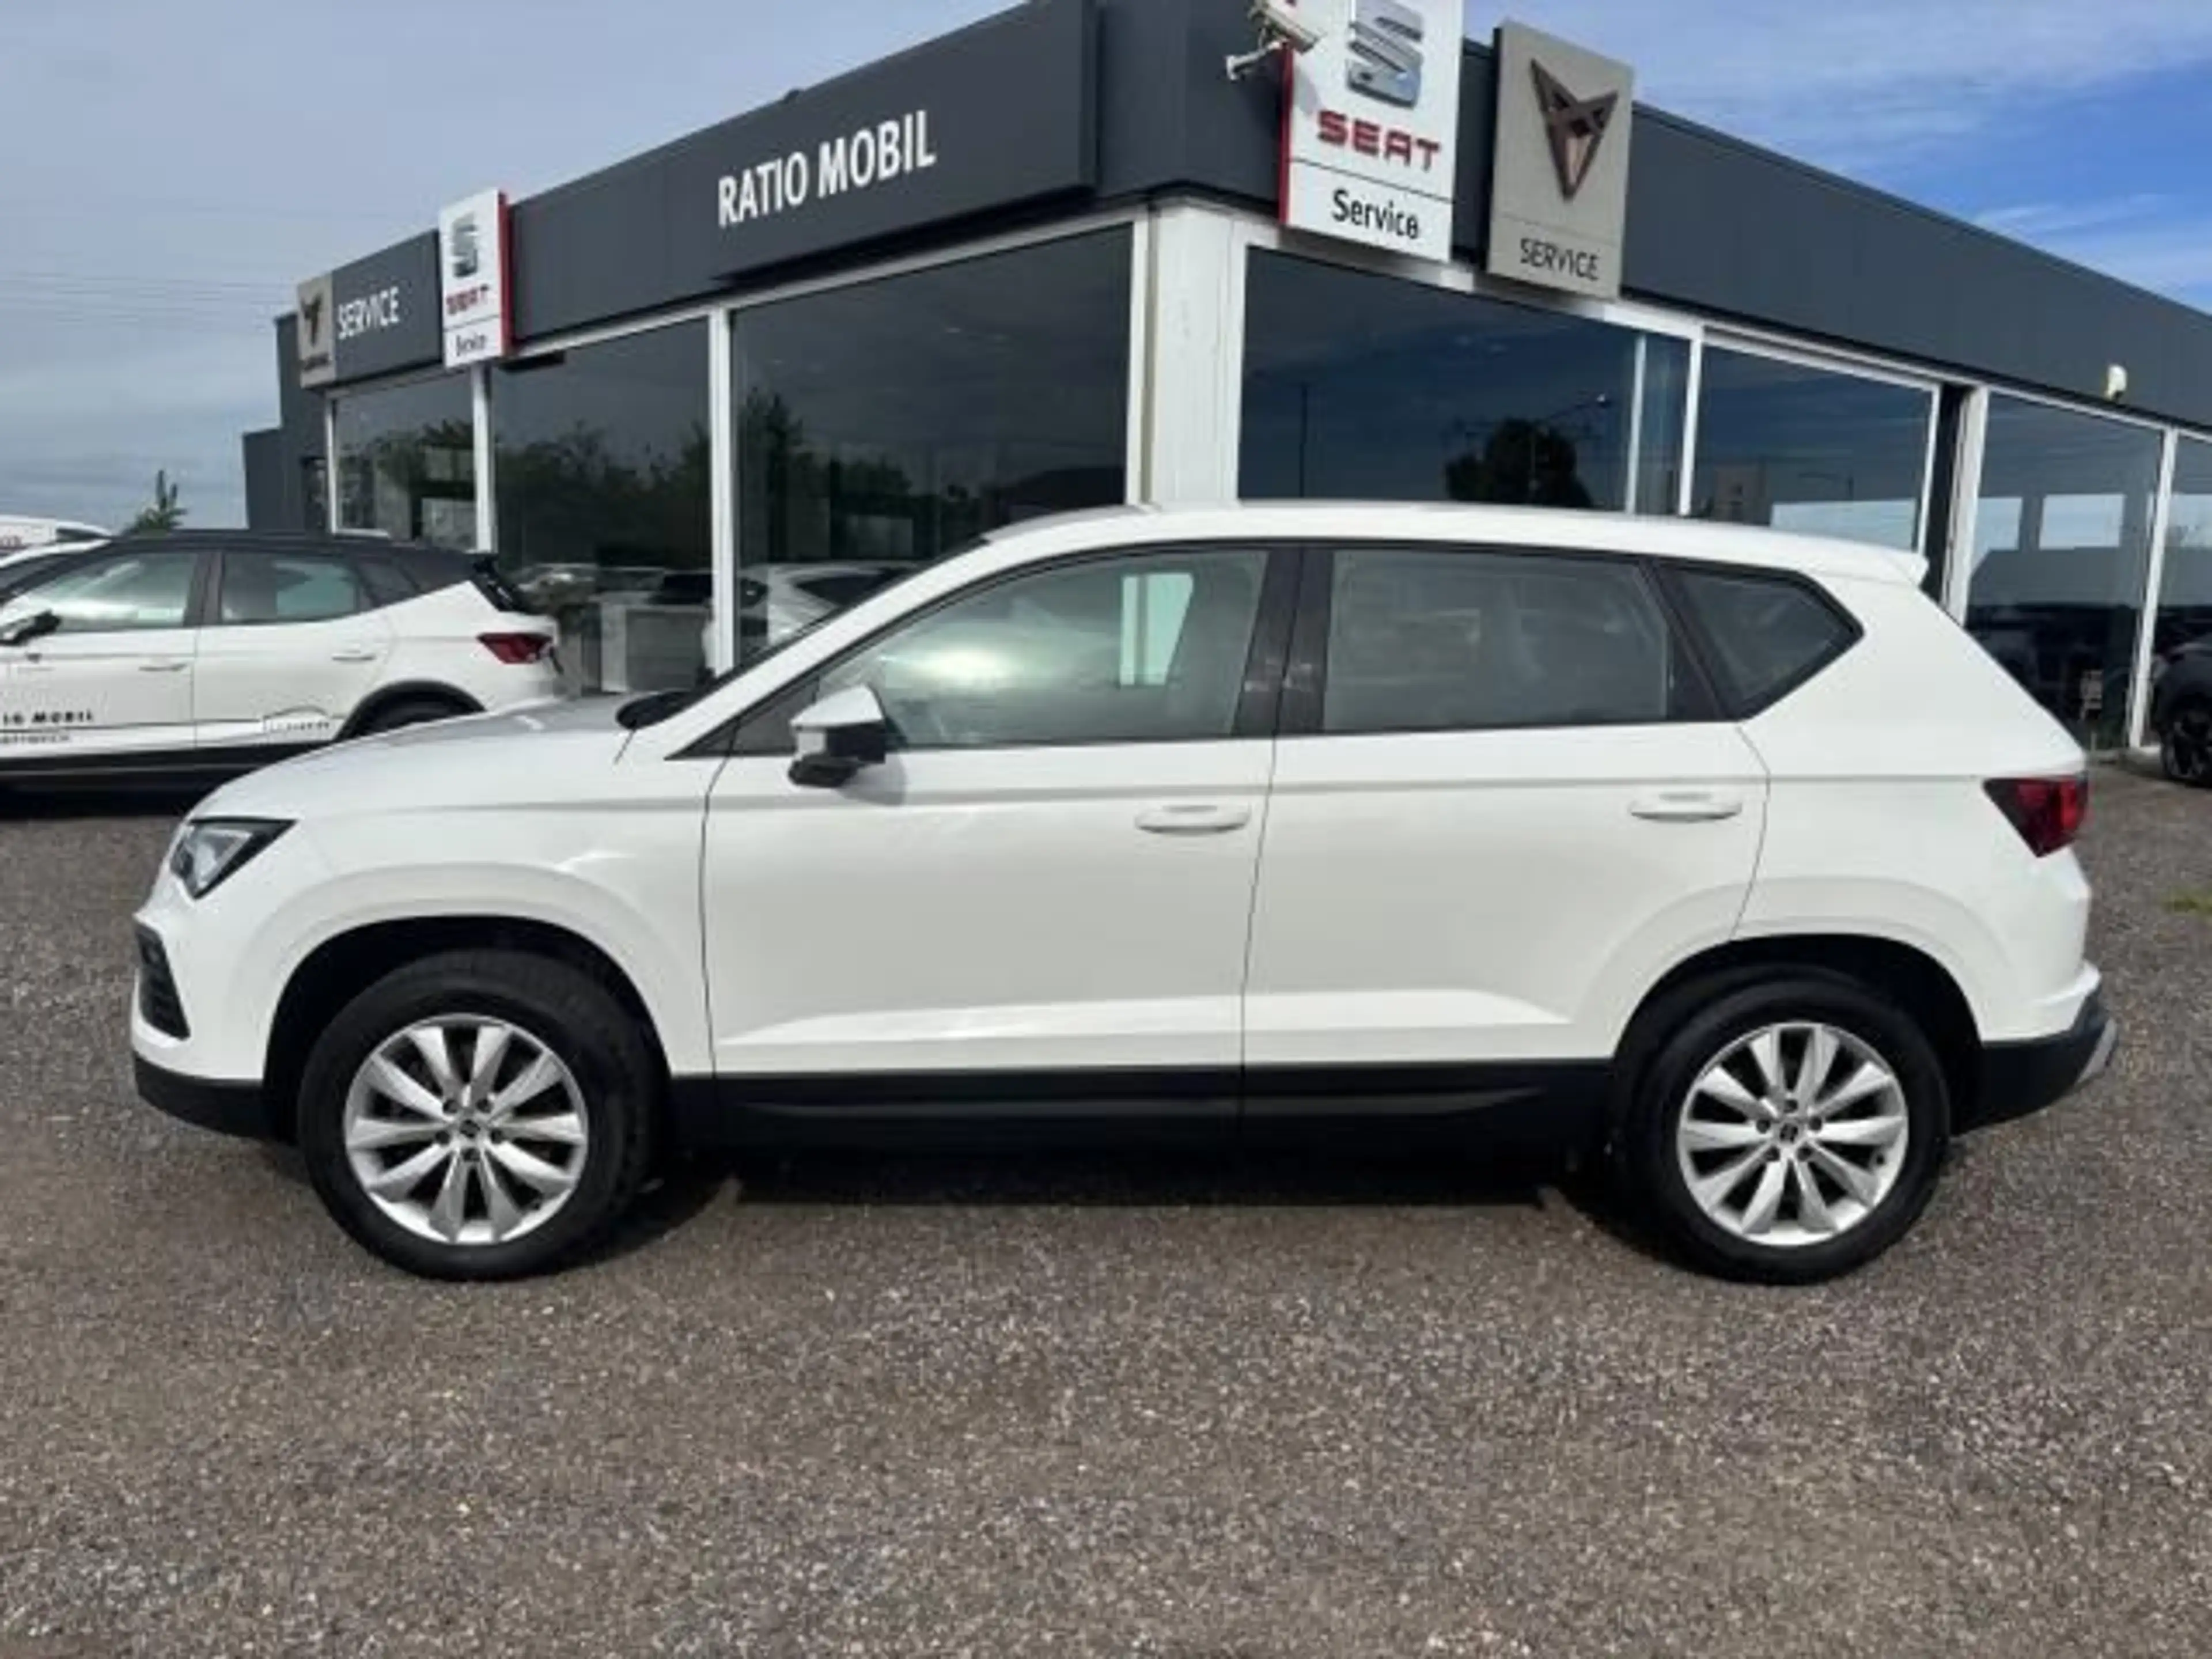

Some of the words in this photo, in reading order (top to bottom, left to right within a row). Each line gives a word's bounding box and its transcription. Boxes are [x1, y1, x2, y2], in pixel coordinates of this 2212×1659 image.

[1317, 110, 1441, 171] SEAT
[718, 151, 809, 229] RATIO
[818, 109, 937, 199] MOBIL
[1331, 189, 1419, 240] Service
[1520, 237, 1600, 281] SERVICE
[338, 286, 400, 340] SERVICE
